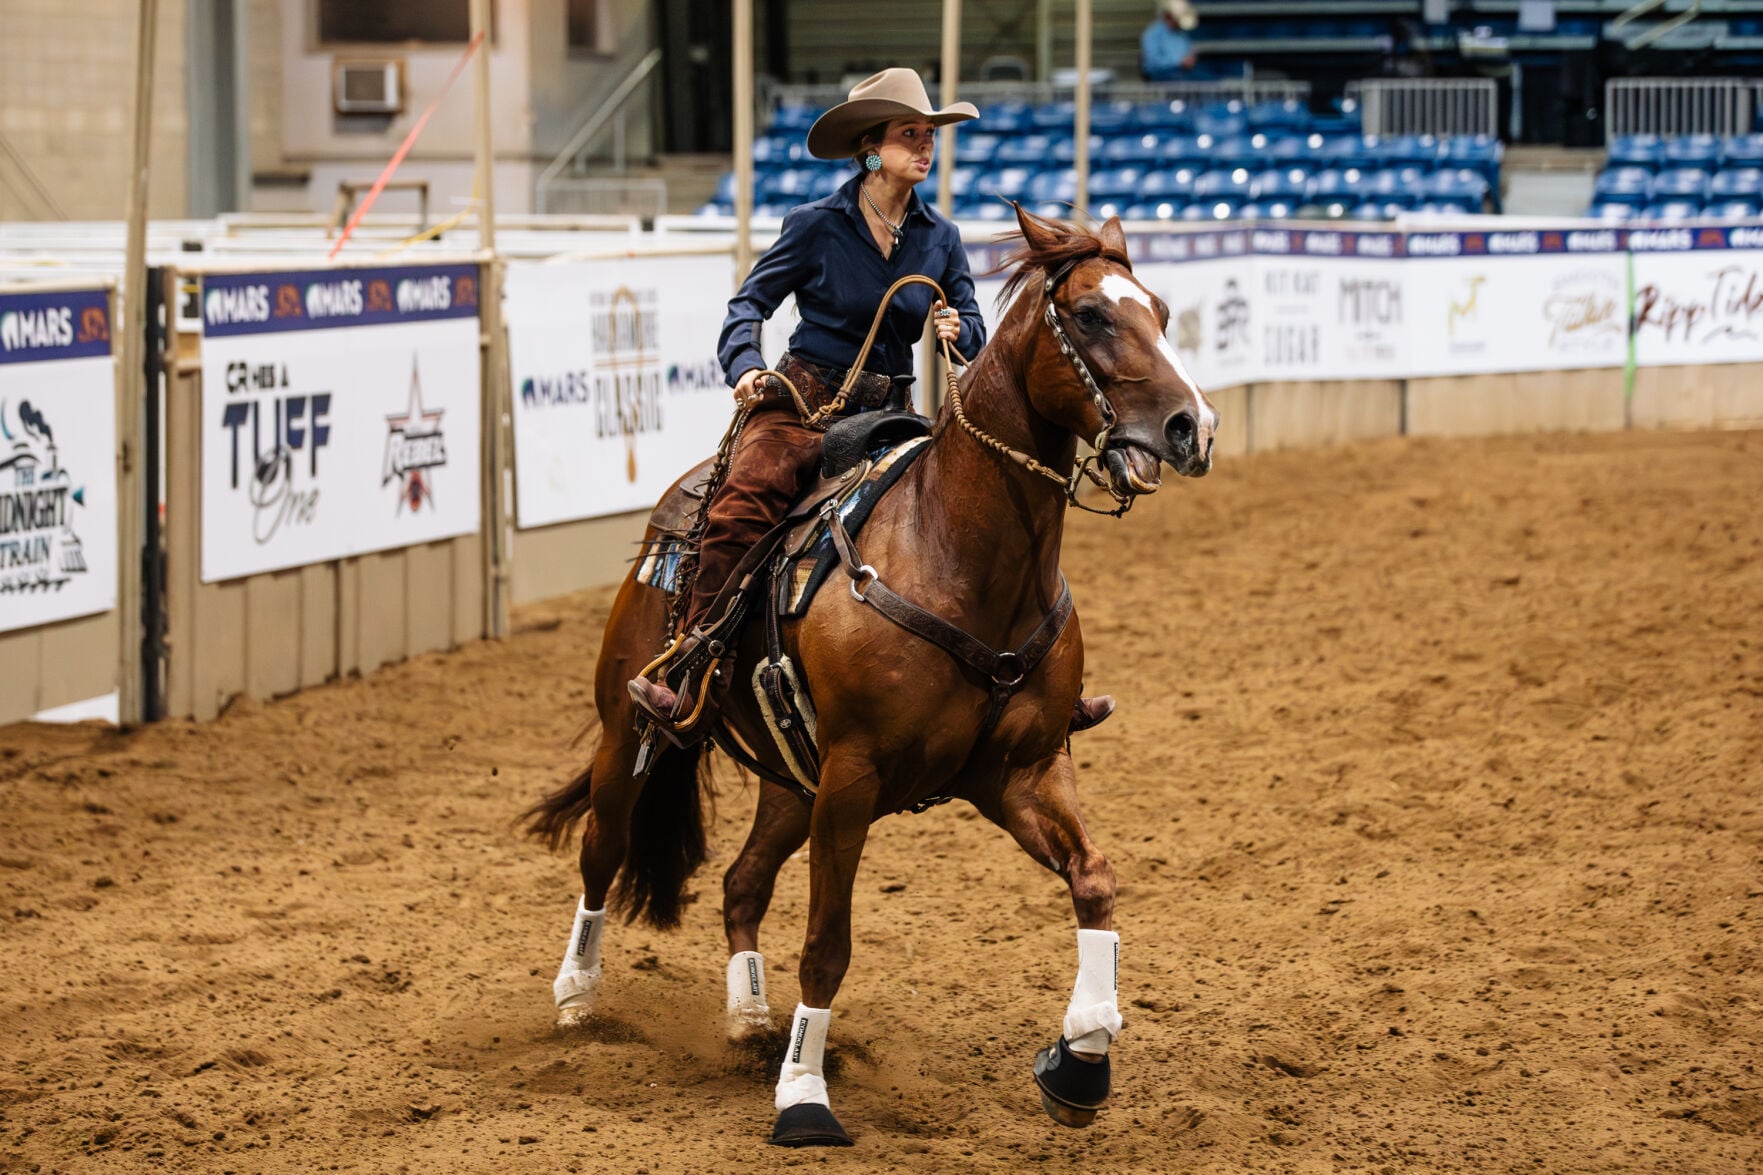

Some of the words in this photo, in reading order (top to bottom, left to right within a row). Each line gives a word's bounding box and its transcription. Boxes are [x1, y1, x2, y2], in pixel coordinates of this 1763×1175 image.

[1643, 230, 1692, 251] MARS
[219, 284, 270, 324] MARS
[318, 279, 364, 317] MARS
[409, 275, 452, 311] MARS
[20, 306, 74, 350] MARS
[537, 370, 588, 406] MARS
[222, 392, 332, 489] TUFF
[249, 446, 319, 546] One
[0, 536, 50, 568] TRAIN
